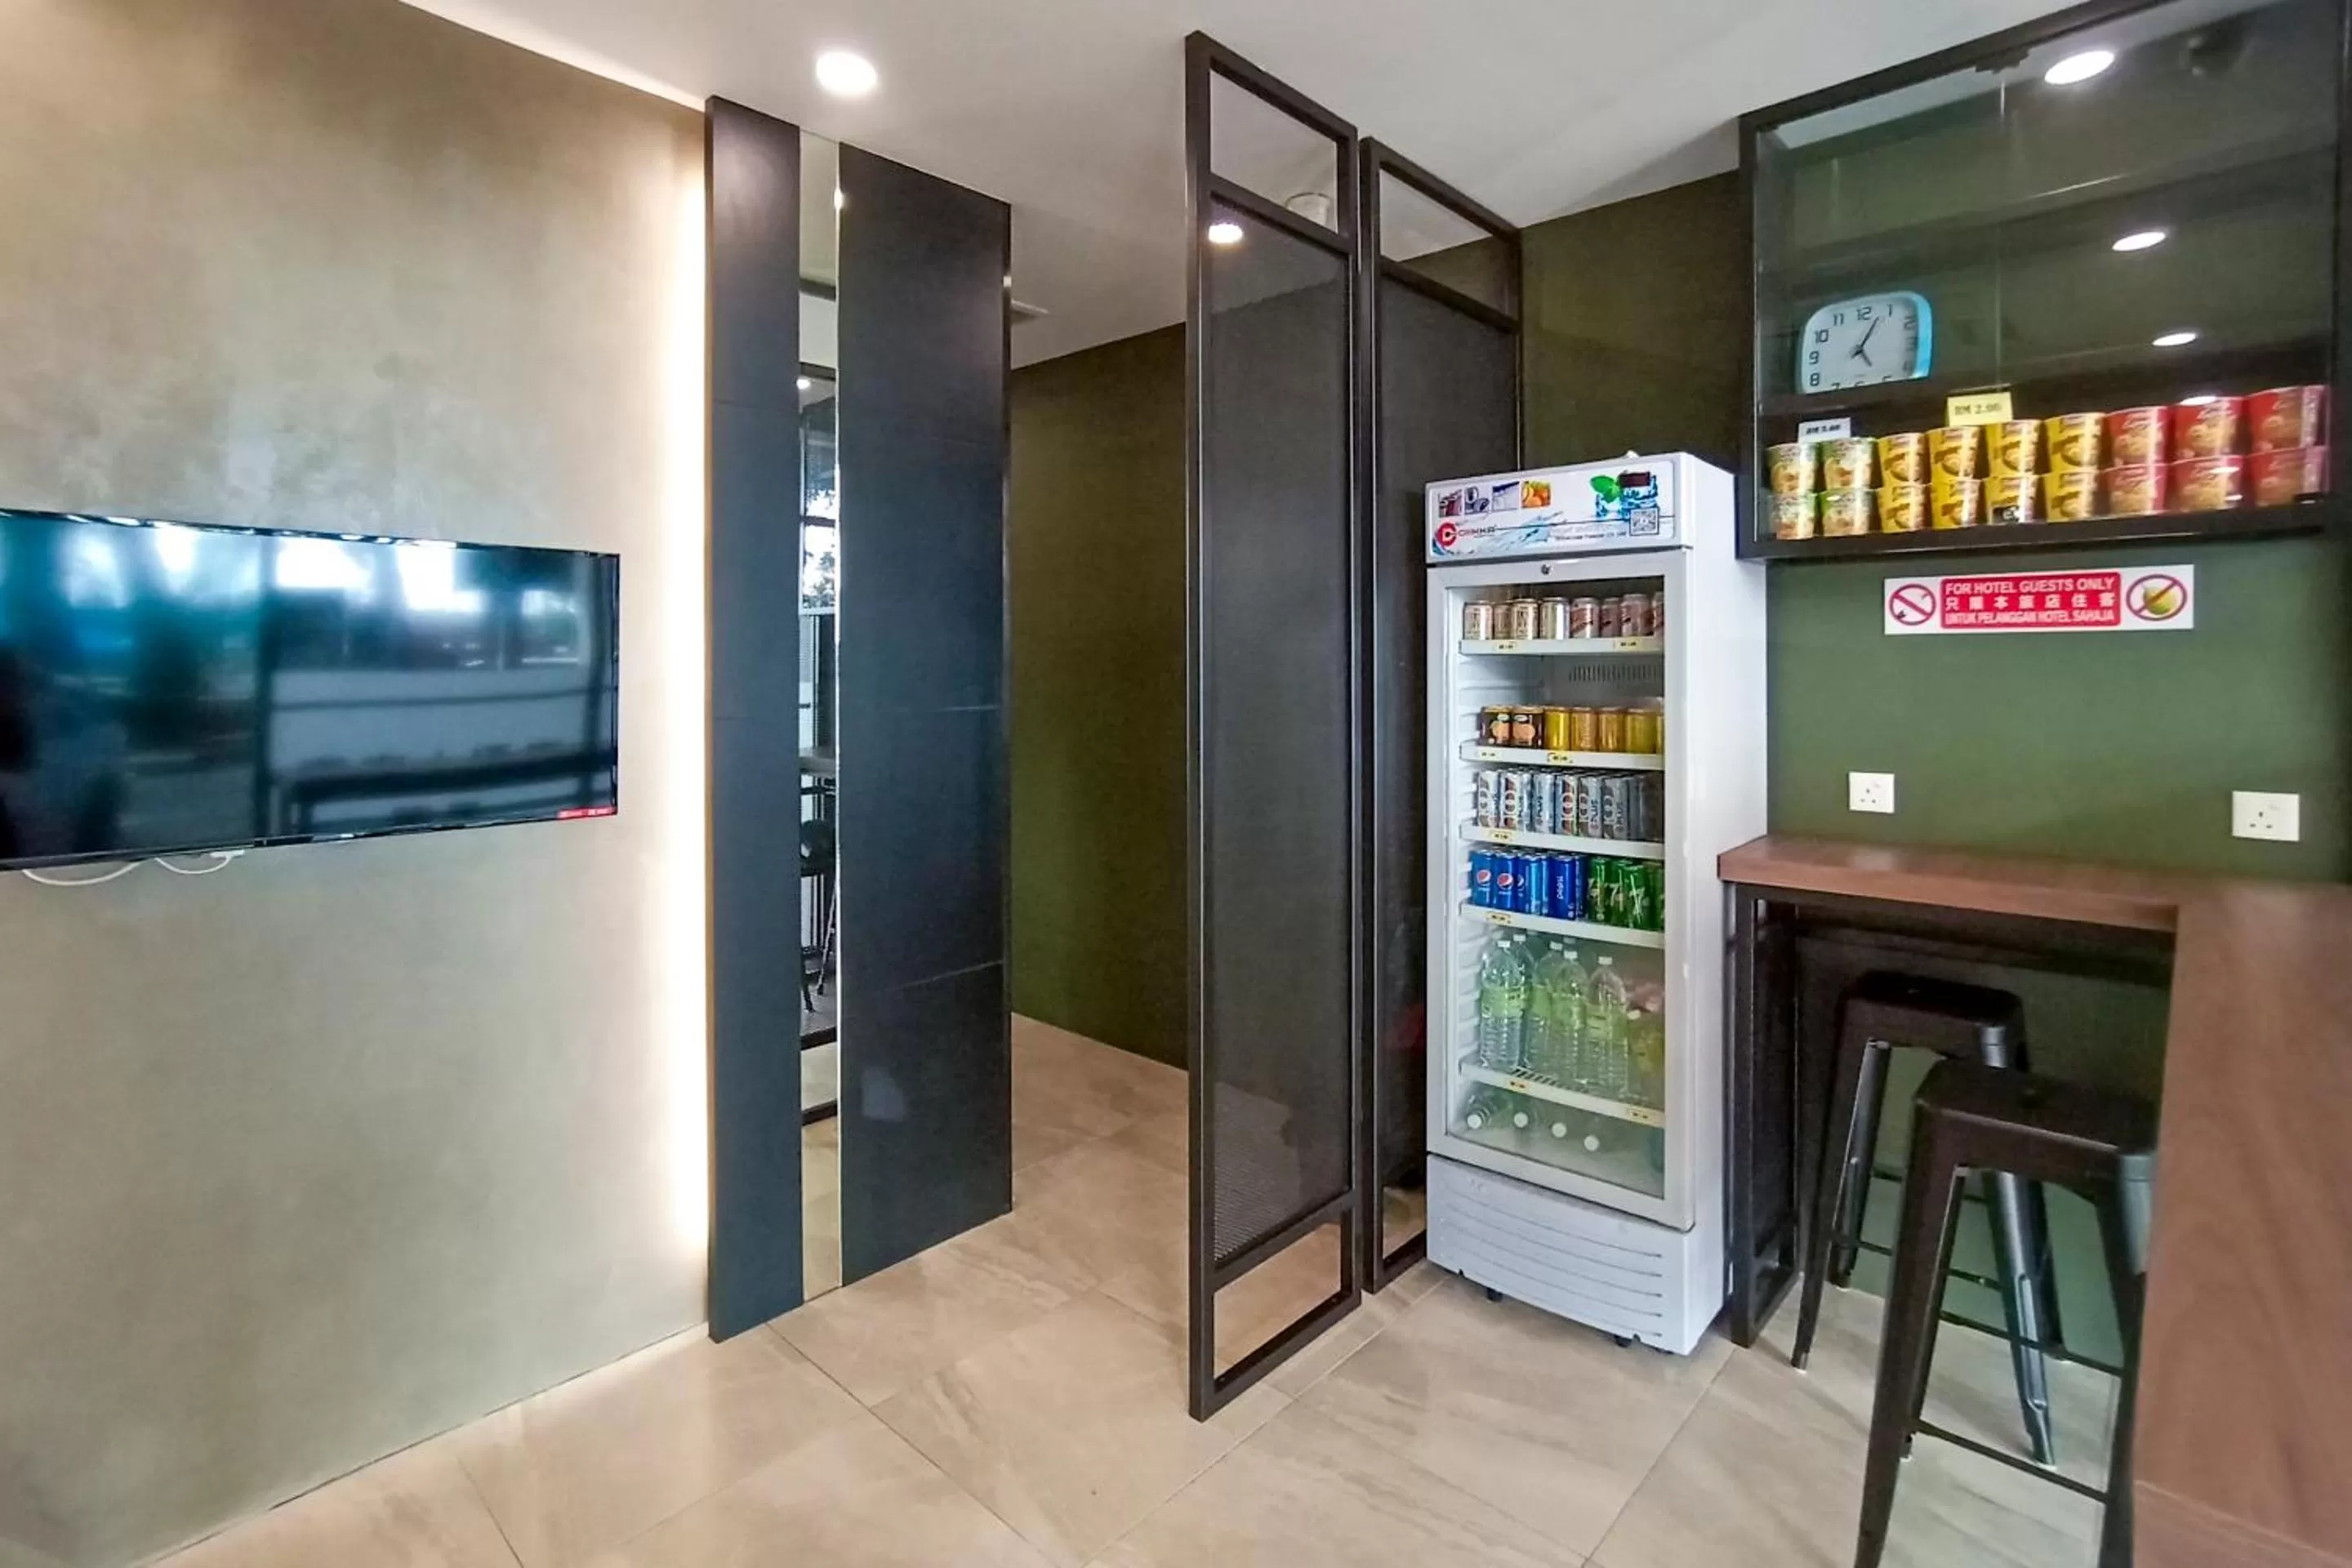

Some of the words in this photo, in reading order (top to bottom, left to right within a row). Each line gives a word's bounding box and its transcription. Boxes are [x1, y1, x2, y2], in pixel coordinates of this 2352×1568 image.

[1856, 306, 1872, 321] 12
[1886, 304, 1893, 318] 1
[1833, 313, 1845, 327] 11
[1815, 328, 1829, 344] 10
[1809, 351, 1820, 365] 9
[1810, 373, 1820, 386] 8
[1945, 582, 1971, 595] FOR
[1974, 581, 2018, 595] HOTEL
[2019, 579, 2074, 594] GUESTS
[2077, 577, 2115, 591] ONLY
[1978, 611, 2036, 624] PELANGGAN
[2038, 611, 2071, 623] HOTEL
